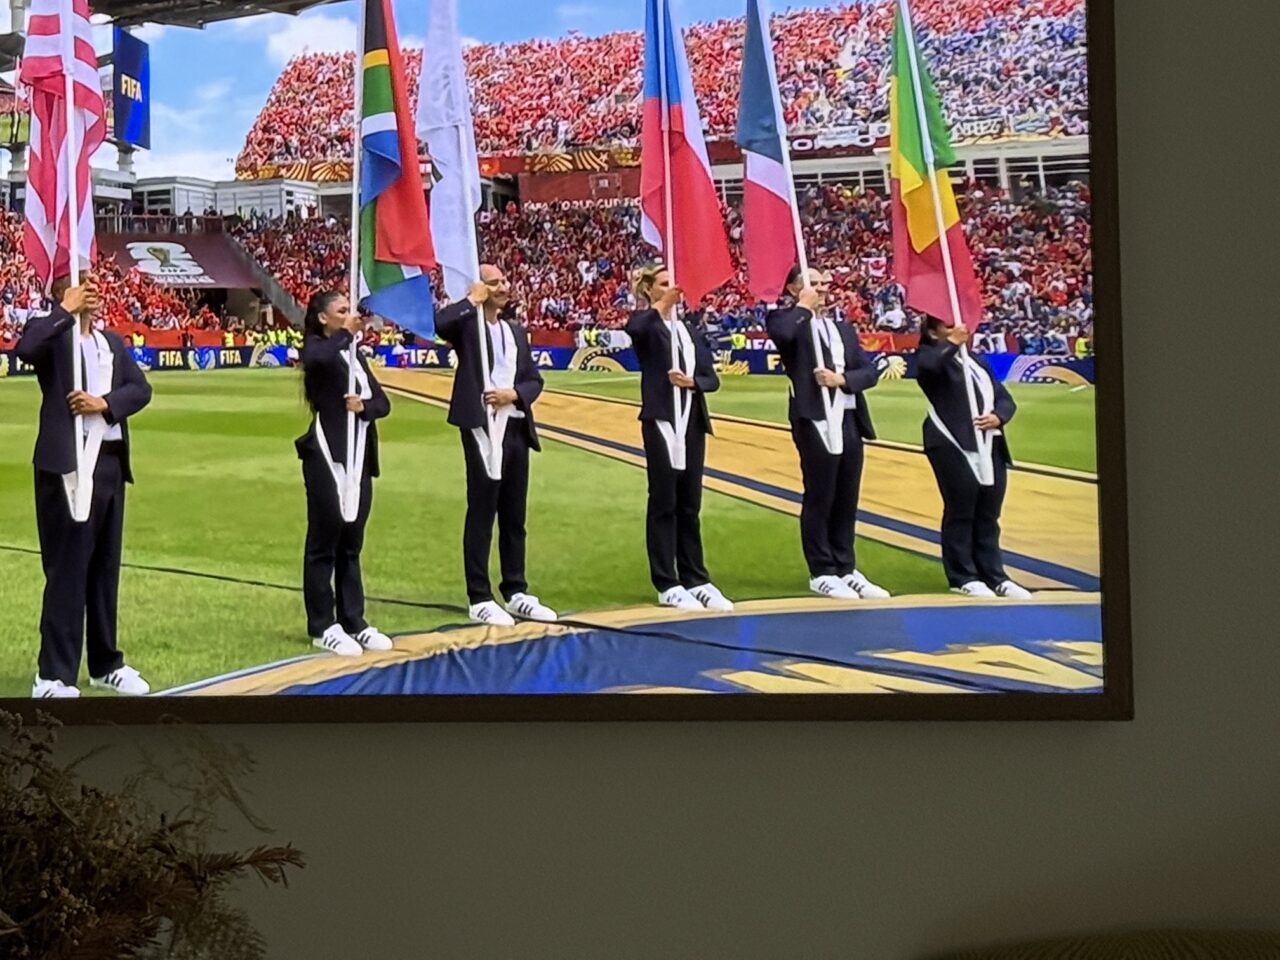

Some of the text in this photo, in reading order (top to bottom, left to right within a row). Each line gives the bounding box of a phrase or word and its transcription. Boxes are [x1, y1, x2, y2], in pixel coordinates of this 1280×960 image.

[121, 73, 142, 102] FIFA
[745, 339, 777, 350] IFA
[159, 350, 183, 366] FIFA
[220, 350, 241, 365] FIFA
[406, 349, 439, 365] IFA
